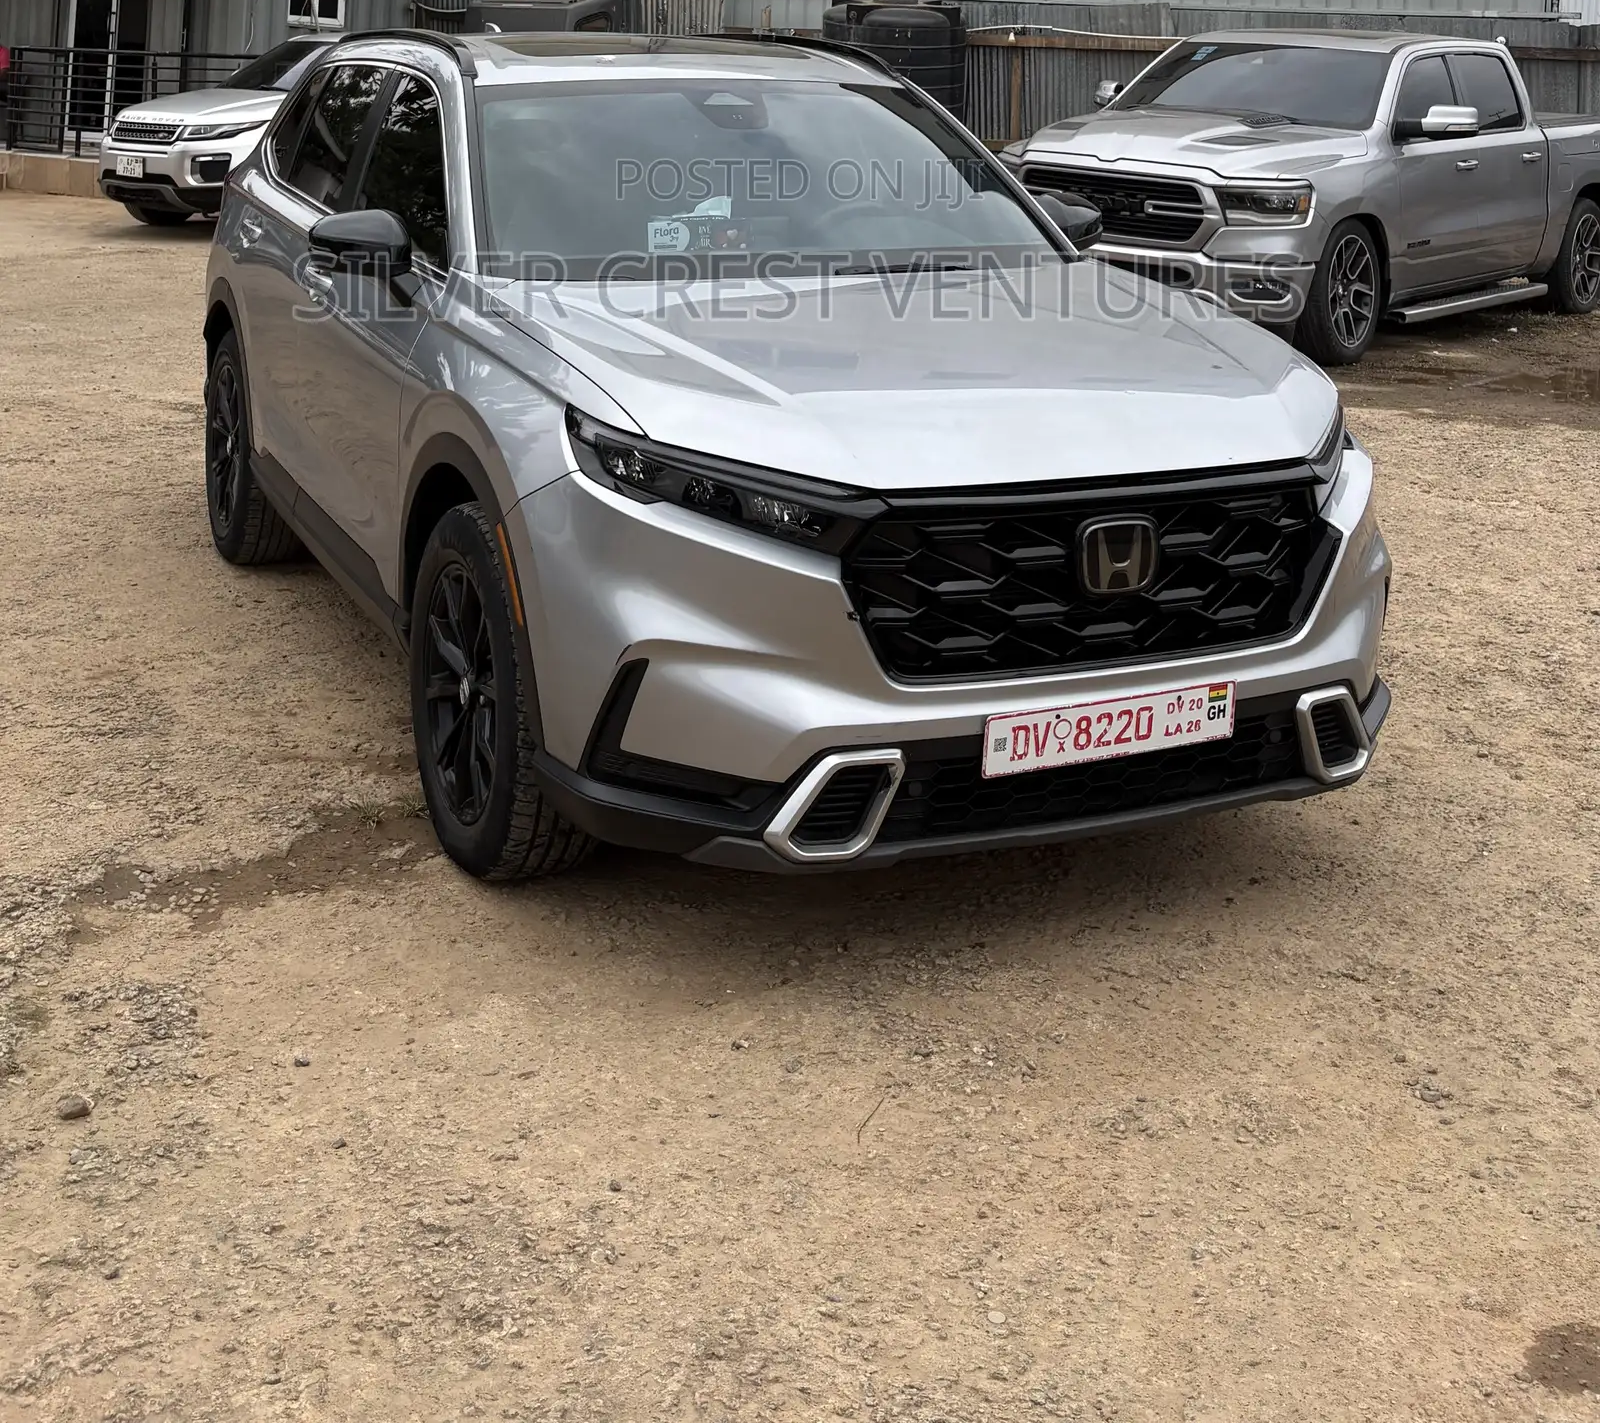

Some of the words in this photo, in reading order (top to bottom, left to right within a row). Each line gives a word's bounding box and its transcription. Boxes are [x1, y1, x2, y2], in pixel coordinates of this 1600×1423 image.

[653, 226, 680, 238] Flora
[1167, 699, 1184, 715] DV
[1188, 697, 1203, 711] 20
[1207, 703, 1227, 721] GH
[1010, 720, 1052, 762] DV
[1073, 705, 1155, 751] 8220
[1164, 722, 1183, 737] LA
